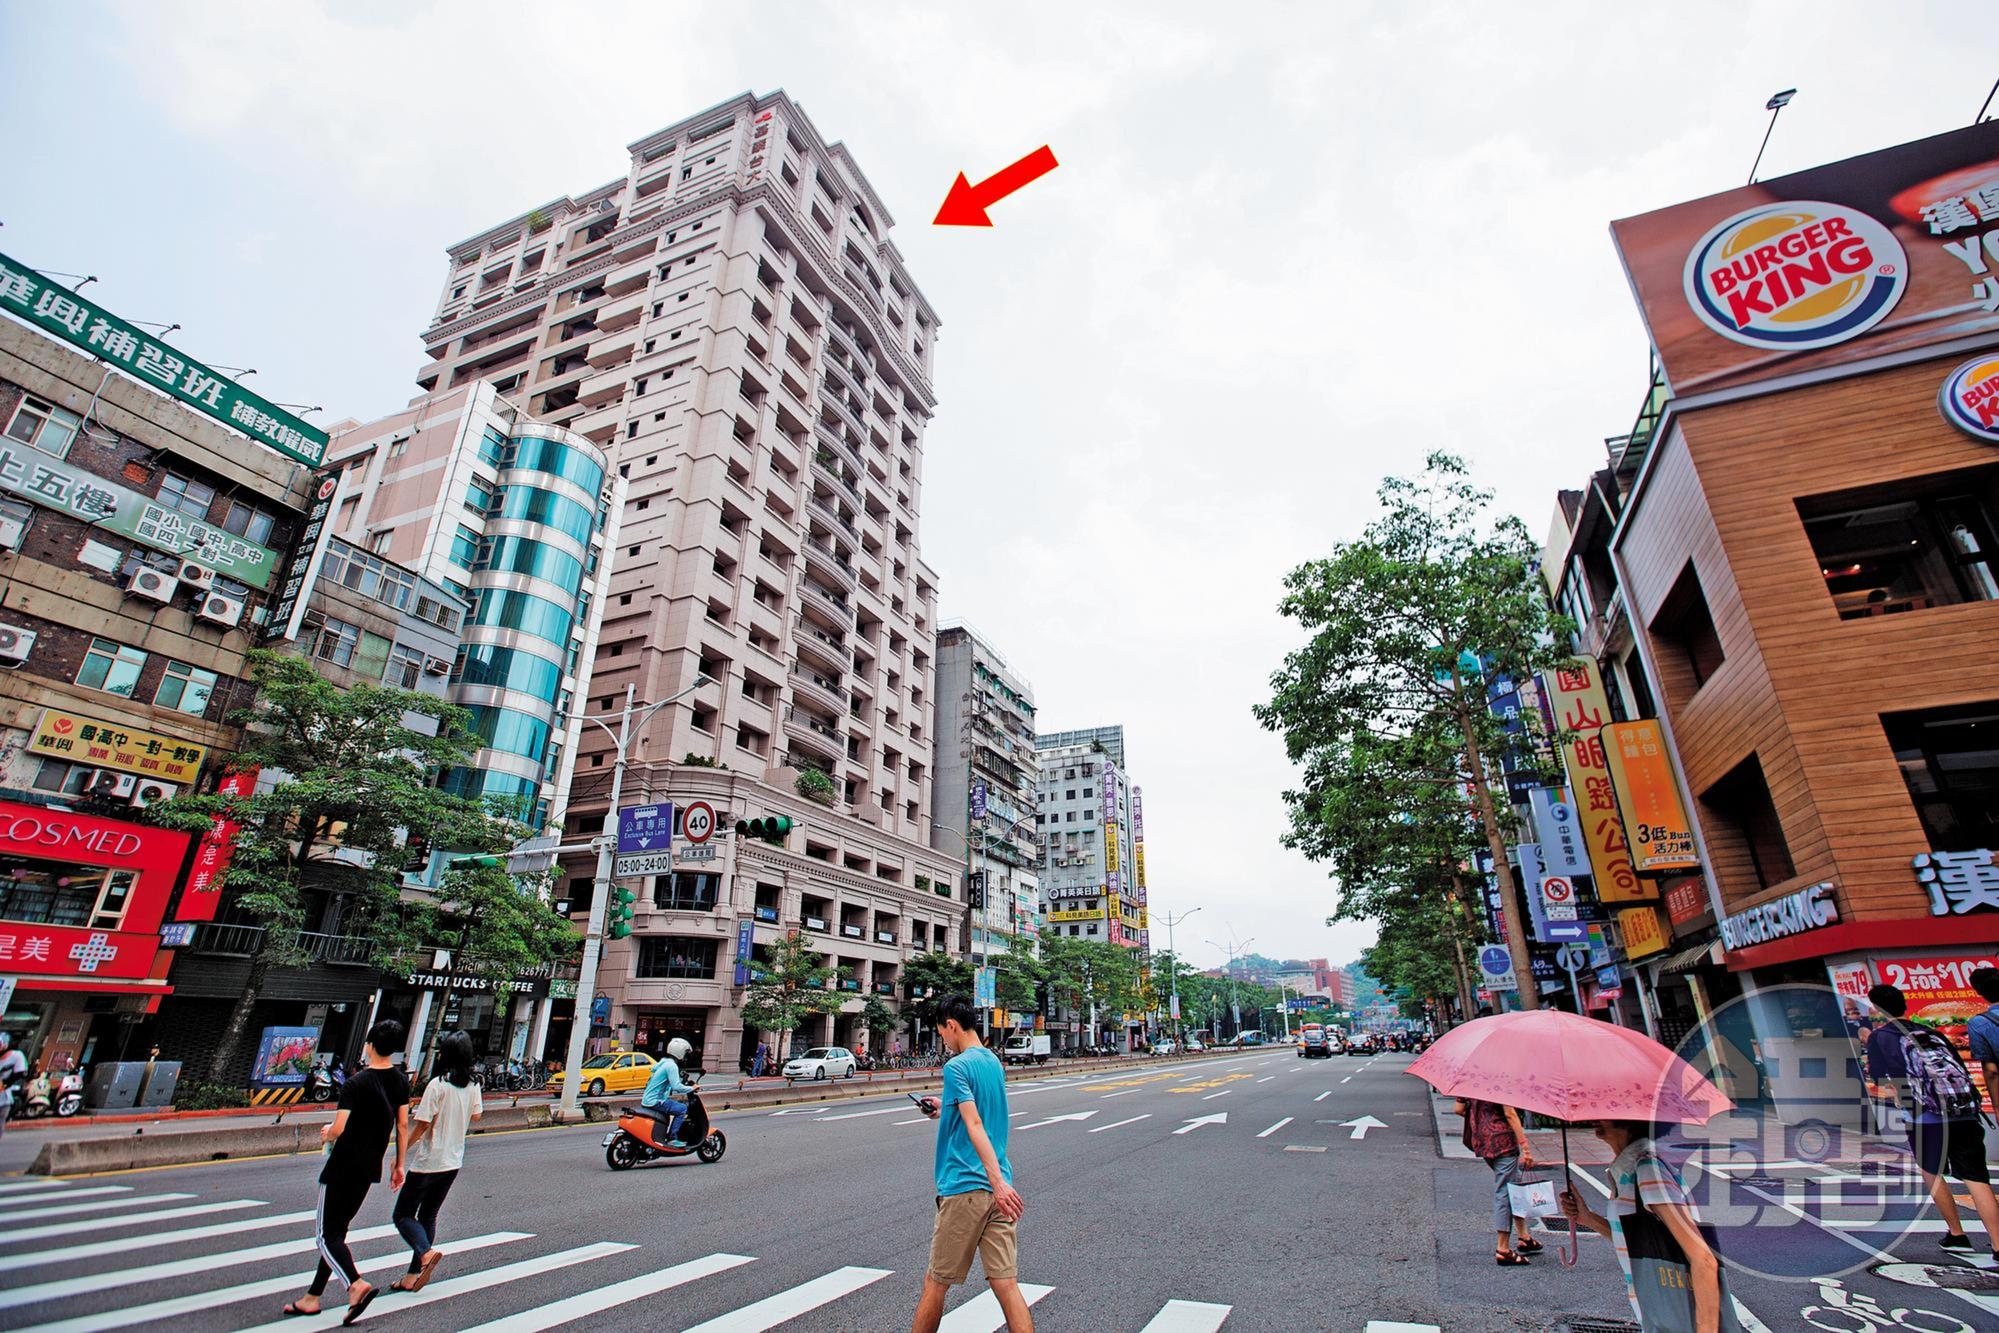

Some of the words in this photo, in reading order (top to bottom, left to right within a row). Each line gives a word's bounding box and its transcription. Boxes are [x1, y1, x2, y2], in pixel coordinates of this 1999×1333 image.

[1709, 216, 1853, 297] BURGER
[1726, 237, 1874, 328] KING
[231, 399, 322, 463] 補教權威
[37, 734, 74, 752] 華興
[625, 817, 666, 832] 公車專用
[689, 815, 708, 830] 40
[624, 831, 644, 839] Exclusive
[1558, 825, 1577, 866] 中華電信
[1670, 831, 1691, 840] Bun
[1654, 841, 1693, 854] 活力棒
[1721, 899, 1781, 950] BURGER
[1780, 882, 1838, 936] KING
[1886, 964, 1911, 990] 2
[1909, 974, 1943, 990] FOR
